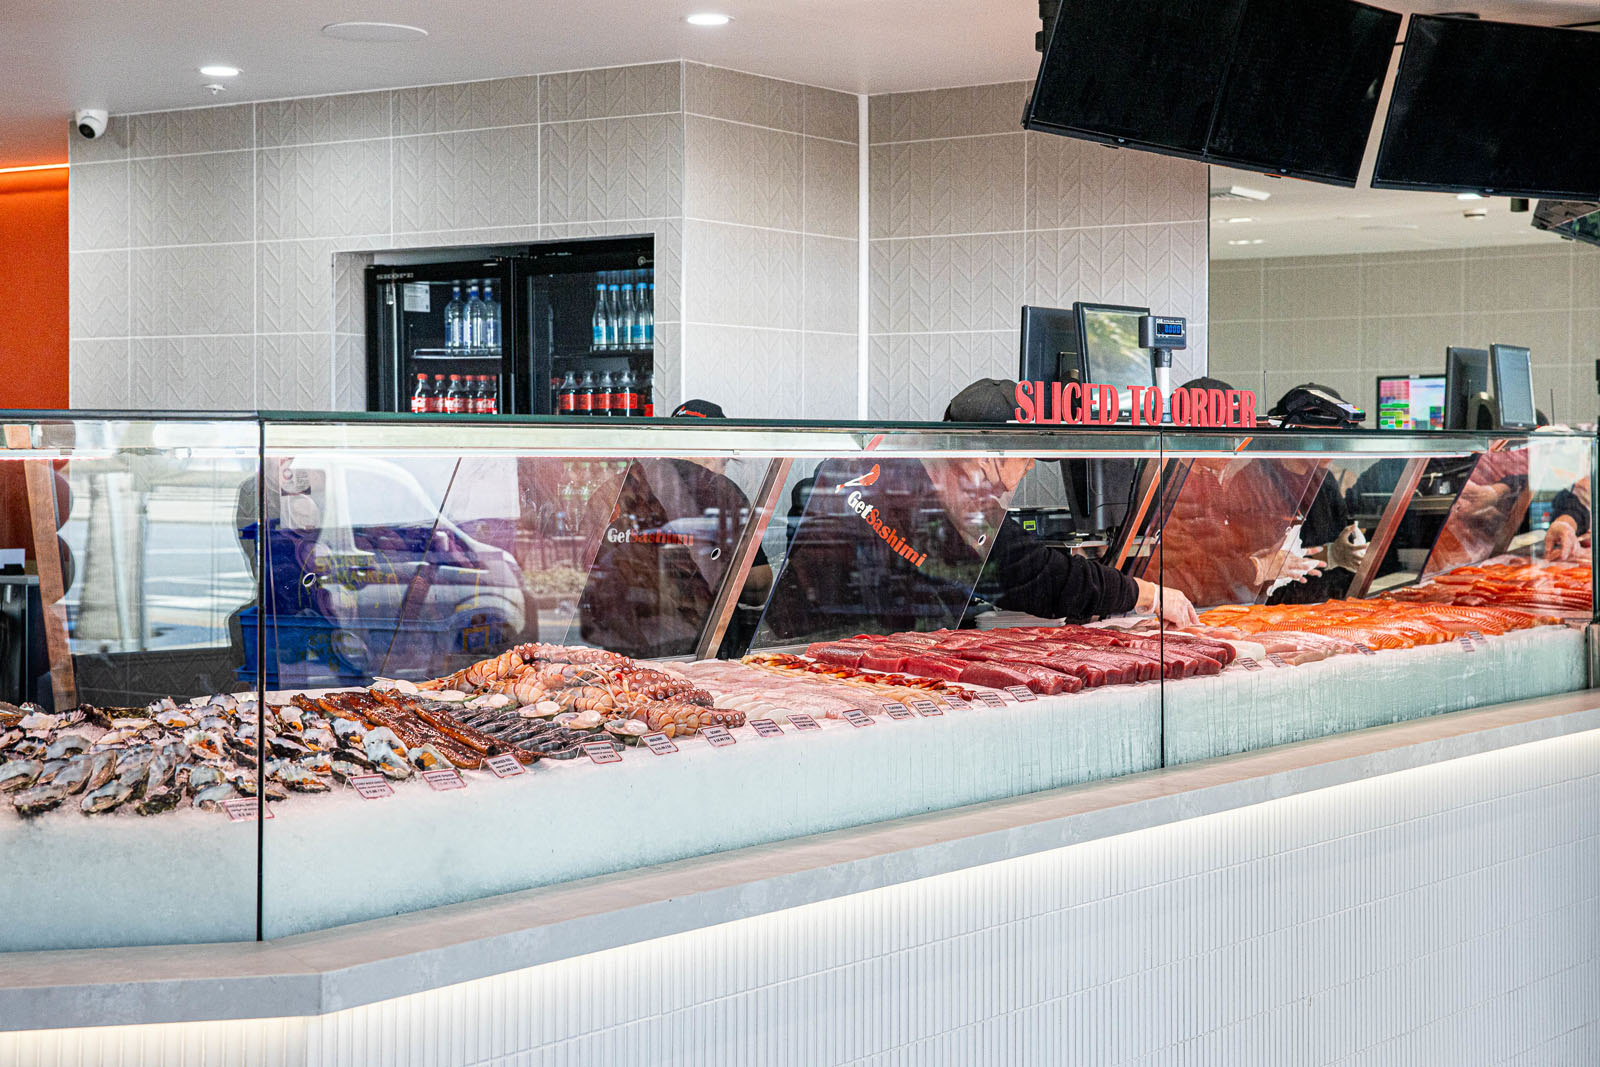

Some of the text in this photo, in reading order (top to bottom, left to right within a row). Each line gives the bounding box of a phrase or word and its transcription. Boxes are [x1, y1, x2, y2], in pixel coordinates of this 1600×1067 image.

[1014, 380, 1257, 428] SLICED TO ORDER
[606, 527, 695, 547] GetSashimi
[847, 489, 930, 569] GetSashimi
